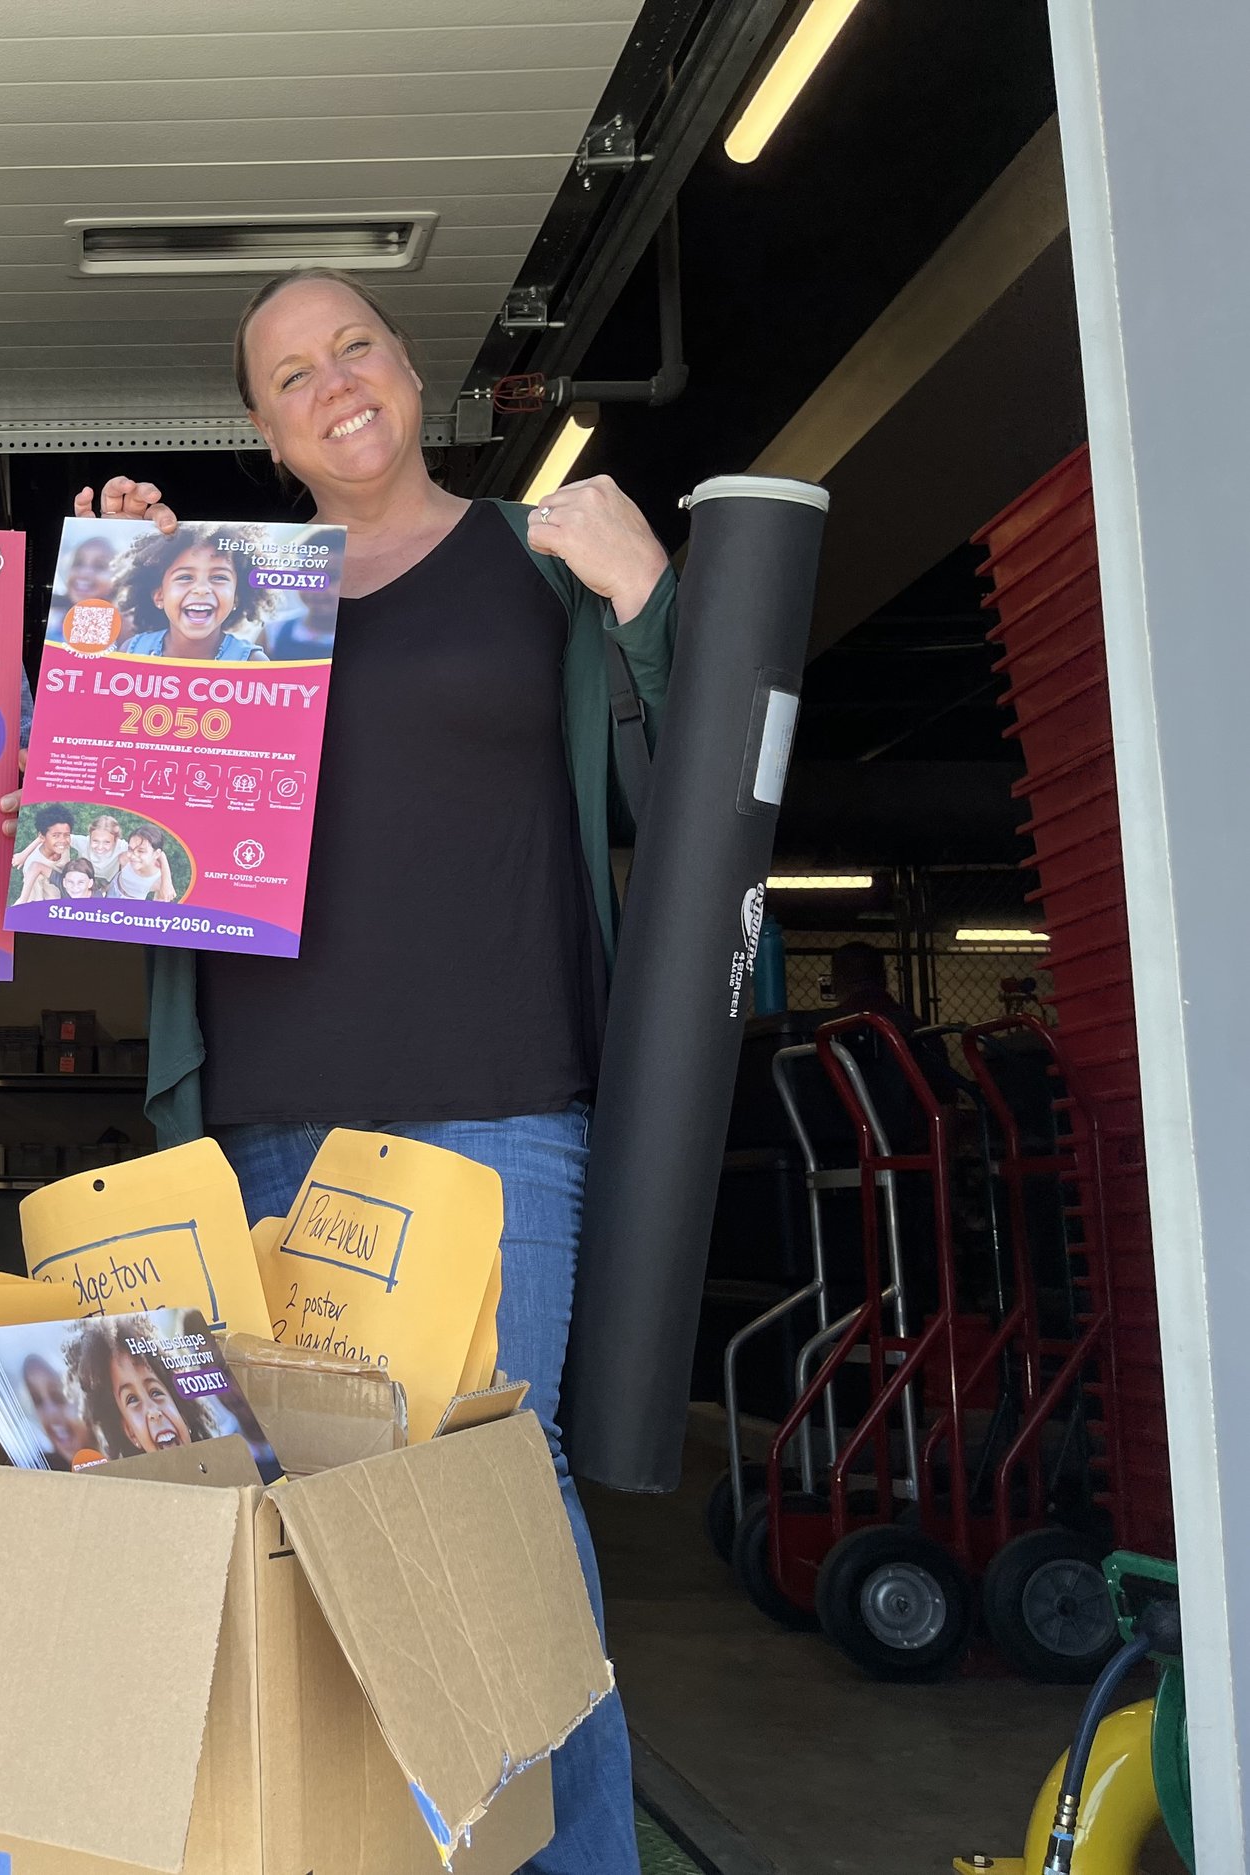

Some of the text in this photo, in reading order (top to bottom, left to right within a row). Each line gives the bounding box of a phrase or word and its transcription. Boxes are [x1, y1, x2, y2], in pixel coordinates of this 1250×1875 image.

[217, 538, 330, 558] Help us shape
[251, 554, 329, 569] tomorrow
[256, 573, 326, 588] TODAY!
[45, 668, 320, 709] ST. LOUIS COUNTY
[119, 702, 232, 741] 2050
[52, 736, 296, 761] AN EQUITABLE AND SUSTAINABLE COMPREHENSIVE PLAN
[204, 871, 288, 885] SAINT LOUIS COUNTY
[48, 905, 254, 937] StLouisCounty2050.com
[286, 1283, 348, 1328] 2 poster
[125, 1332, 207, 1357] Help us shape
[161, 1351, 215, 1370] tomorrow
[176, 1372, 229, 1395] TODAY!
